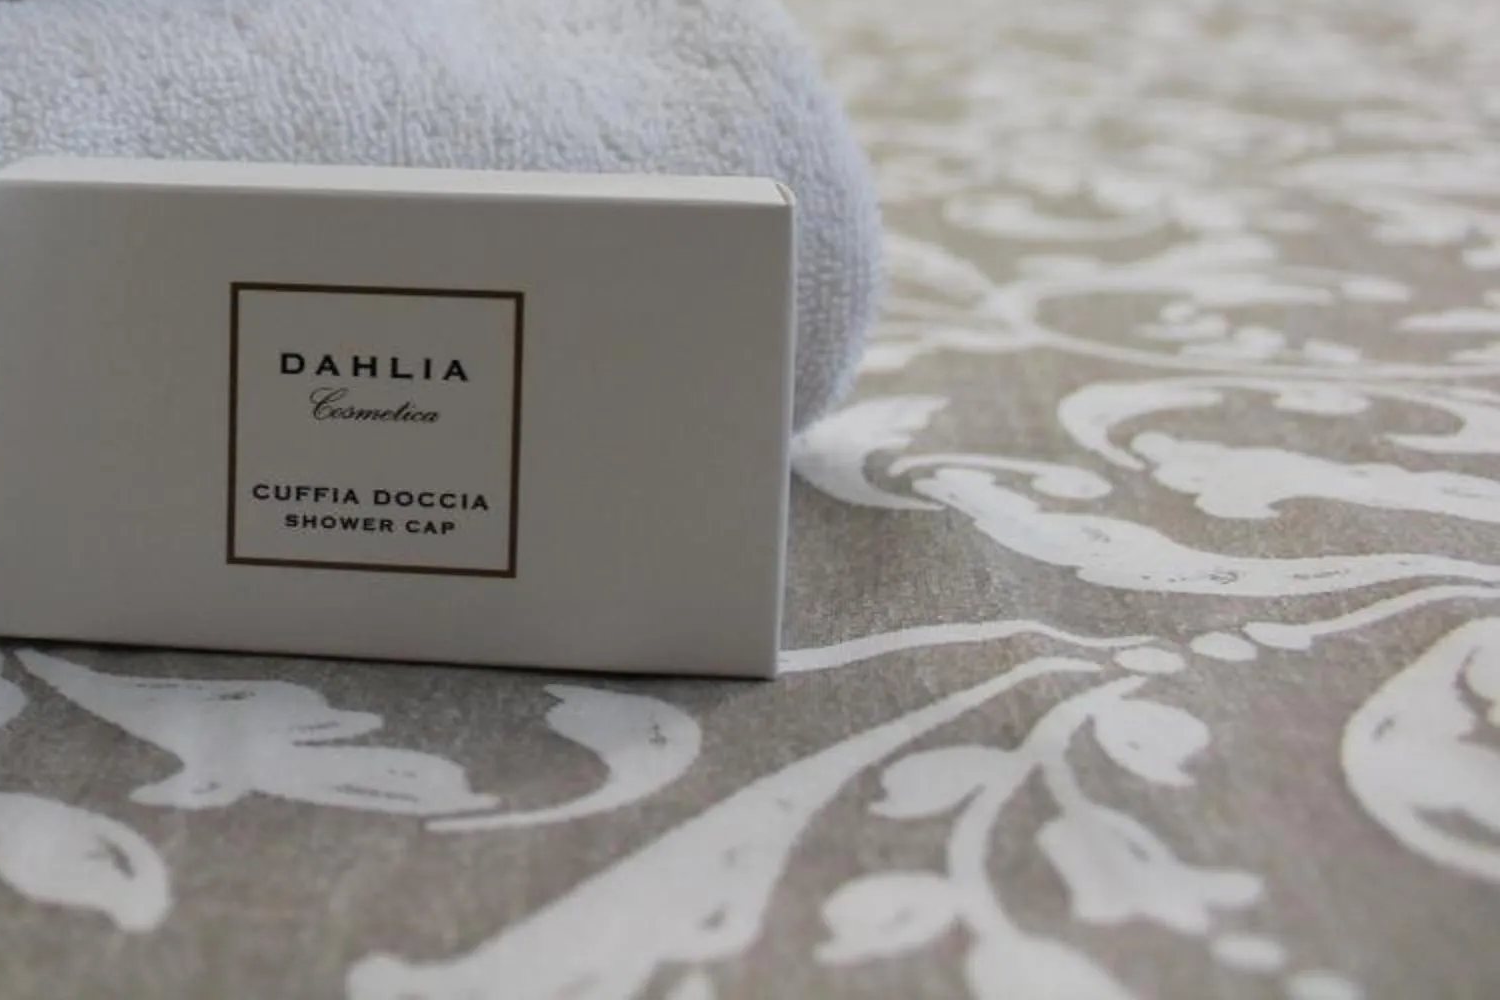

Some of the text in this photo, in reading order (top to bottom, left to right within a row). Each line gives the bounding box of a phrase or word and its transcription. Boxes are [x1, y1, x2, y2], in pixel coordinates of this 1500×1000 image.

[280, 353, 468, 382] DAHLIA
[309, 387, 440, 424] Cosmetica
[252, 484, 490, 511] CUFFIA DOCCIA
[285, 514, 456, 535] SHOWER CAP
